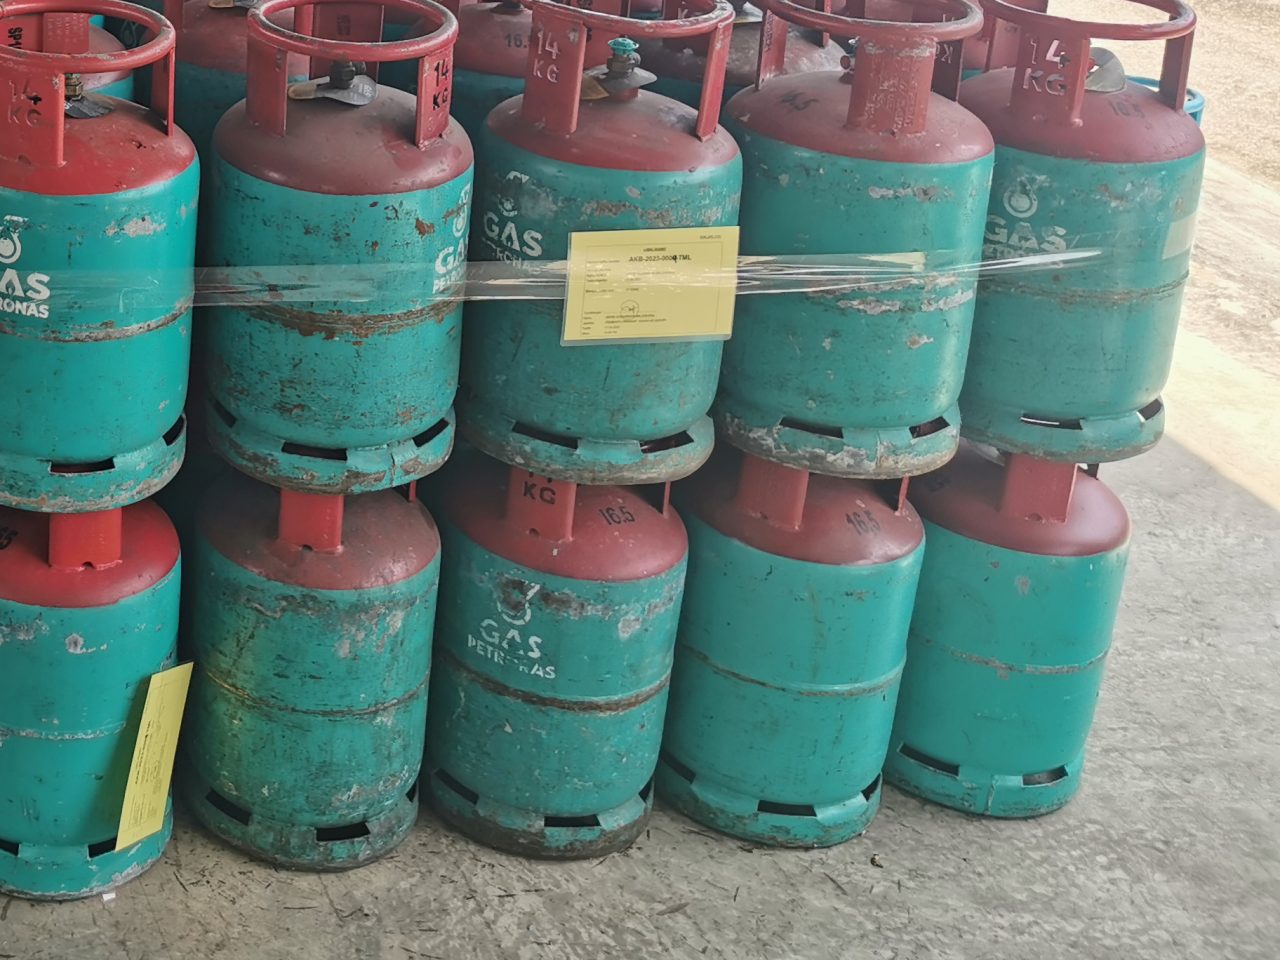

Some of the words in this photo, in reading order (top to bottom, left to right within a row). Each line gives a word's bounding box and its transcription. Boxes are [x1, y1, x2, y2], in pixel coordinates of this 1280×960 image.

[537, 30, 559, 59] 14
[1027, 39, 1070, 68] 14
[433, 58, 449, 87] 14
[533, 59, 559, 84] KG
[1022, 68, 1068, 95] KG
[8, 79, 42, 105] 14
[432, 88, 449, 110] KG
[8, 106, 42, 128] KG
[484, 211, 543, 257] GAS
[983, 213, 1067, 253] GAS
[435, 237, 468, 275] GA
[523, 481, 556, 505] KG
[480, 618, 543, 659] GAS
